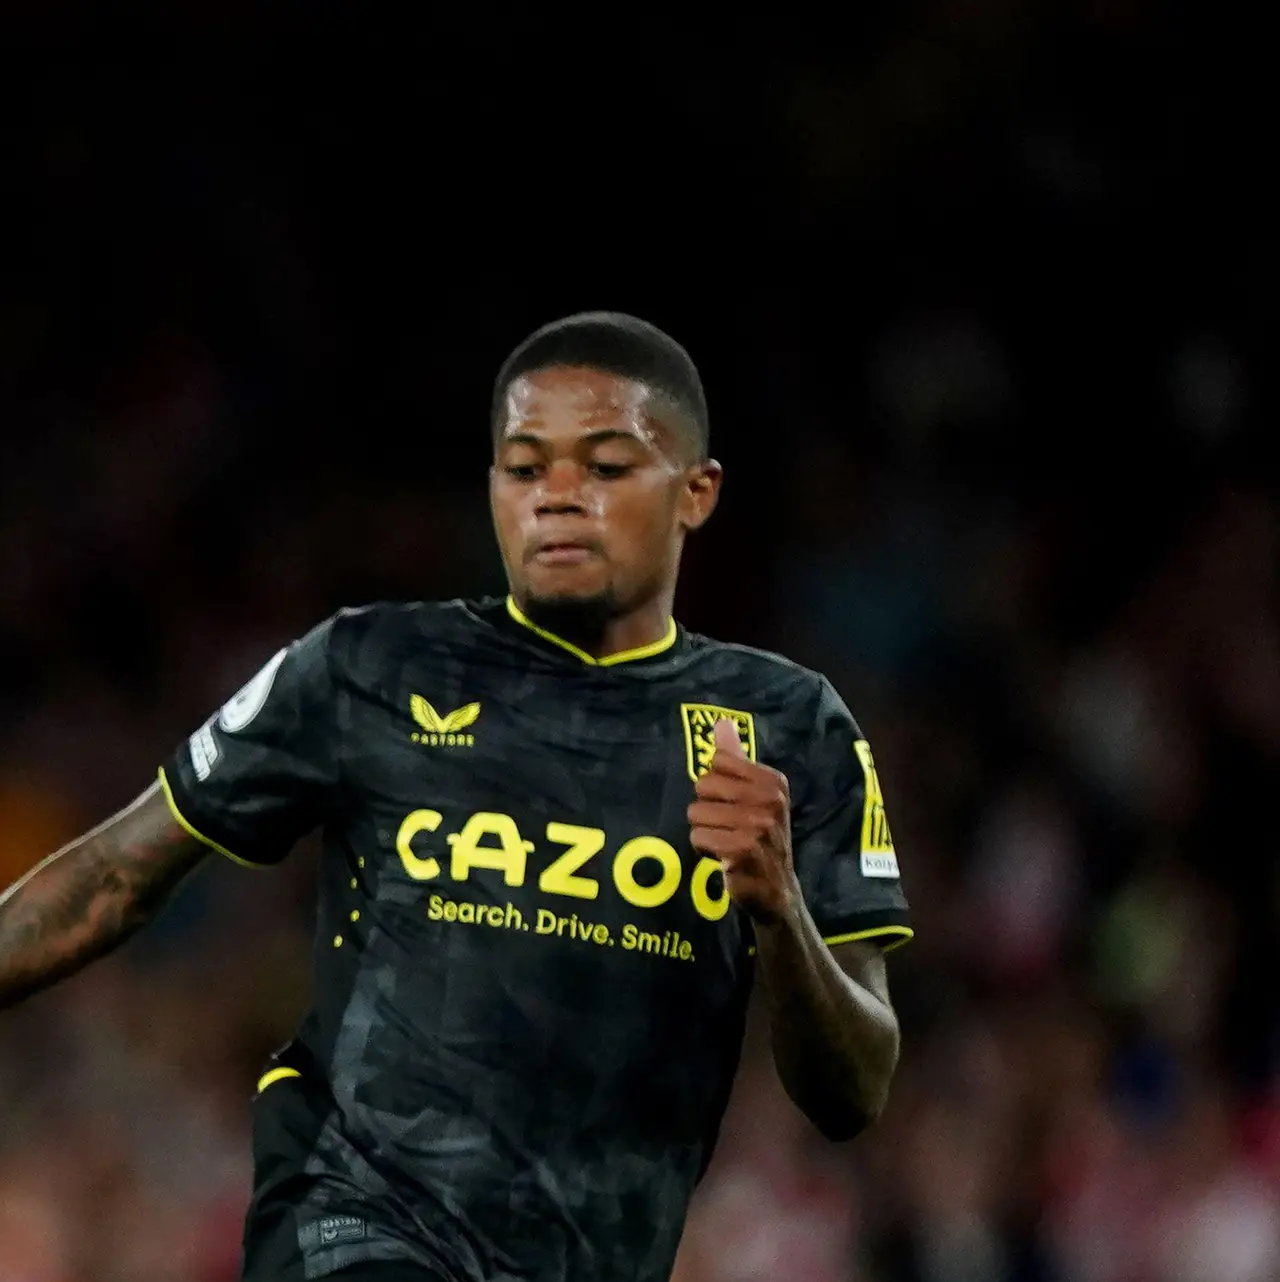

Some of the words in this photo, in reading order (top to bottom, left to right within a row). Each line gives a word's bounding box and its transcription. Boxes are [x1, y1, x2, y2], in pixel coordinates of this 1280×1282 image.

[395, 808, 731, 922] CAZOO
[427, 894, 530, 932] Search.
[535, 907, 615, 947] Drive.
[620, 922, 696, 963] Smile.
